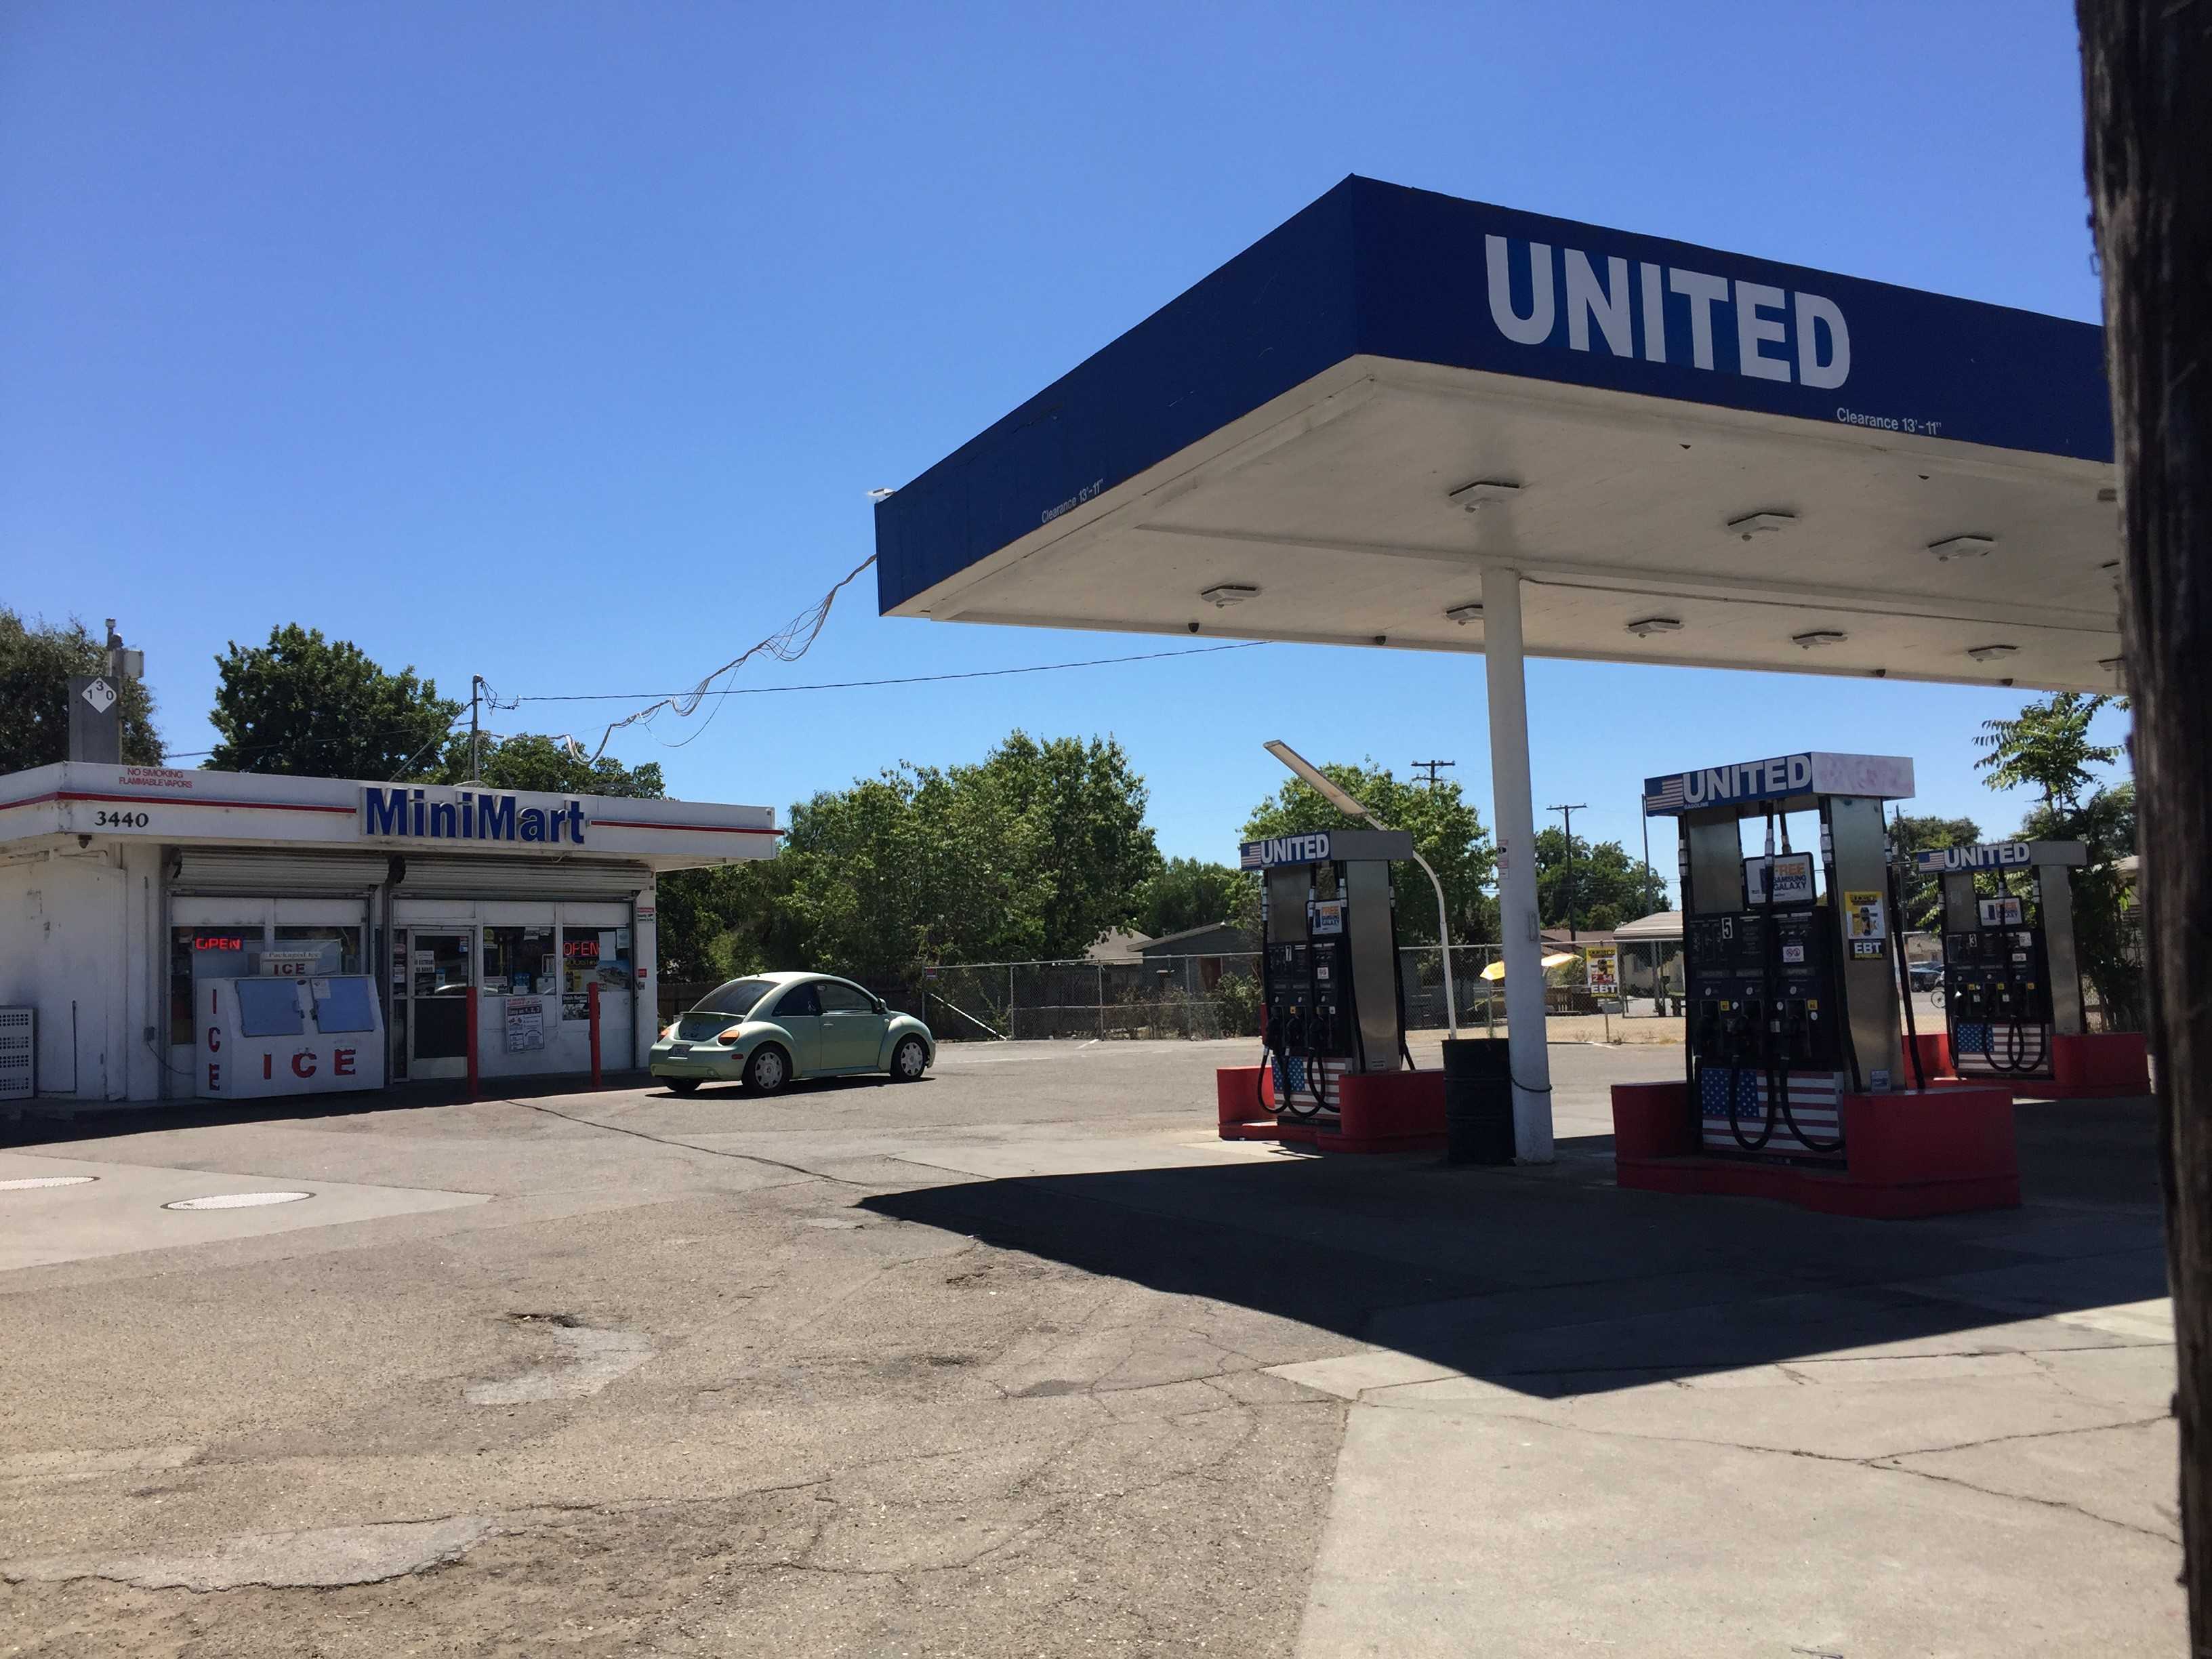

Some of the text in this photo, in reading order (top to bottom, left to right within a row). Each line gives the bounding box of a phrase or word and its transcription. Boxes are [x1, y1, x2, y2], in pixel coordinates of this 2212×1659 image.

[1486, 234, 1850, 390] UNITED
[1837, 407, 1898, 430] Clearance
[1042, 497, 1077, 523] Clearance
[96, 680, 104, 691] 3
[127, 768, 184, 779] NO SMOKING
[1682, 755, 1812, 804] UNITED
[119, 777, 193, 789] FLAMMABLE VAPORS
[94, 811, 149, 827] 3440
[365, 787, 585, 844] MiniMart
[1261, 834, 1330, 863] UNITED
[1944, 842, 2030, 868] UNITED
[1722, 918, 1732, 937] 5
[195, 937, 243, 950] OPEN
[563, 941, 599, 956] OPEN
[1854, 942, 1881, 954] EBT
[1969, 934, 1977, 947] 3
[274, 962, 306, 976] ICE
[1591, 984, 1616, 994] EBT
[208, 988, 221, 1091] ICE
[264, 1048, 356, 1080] ICE
